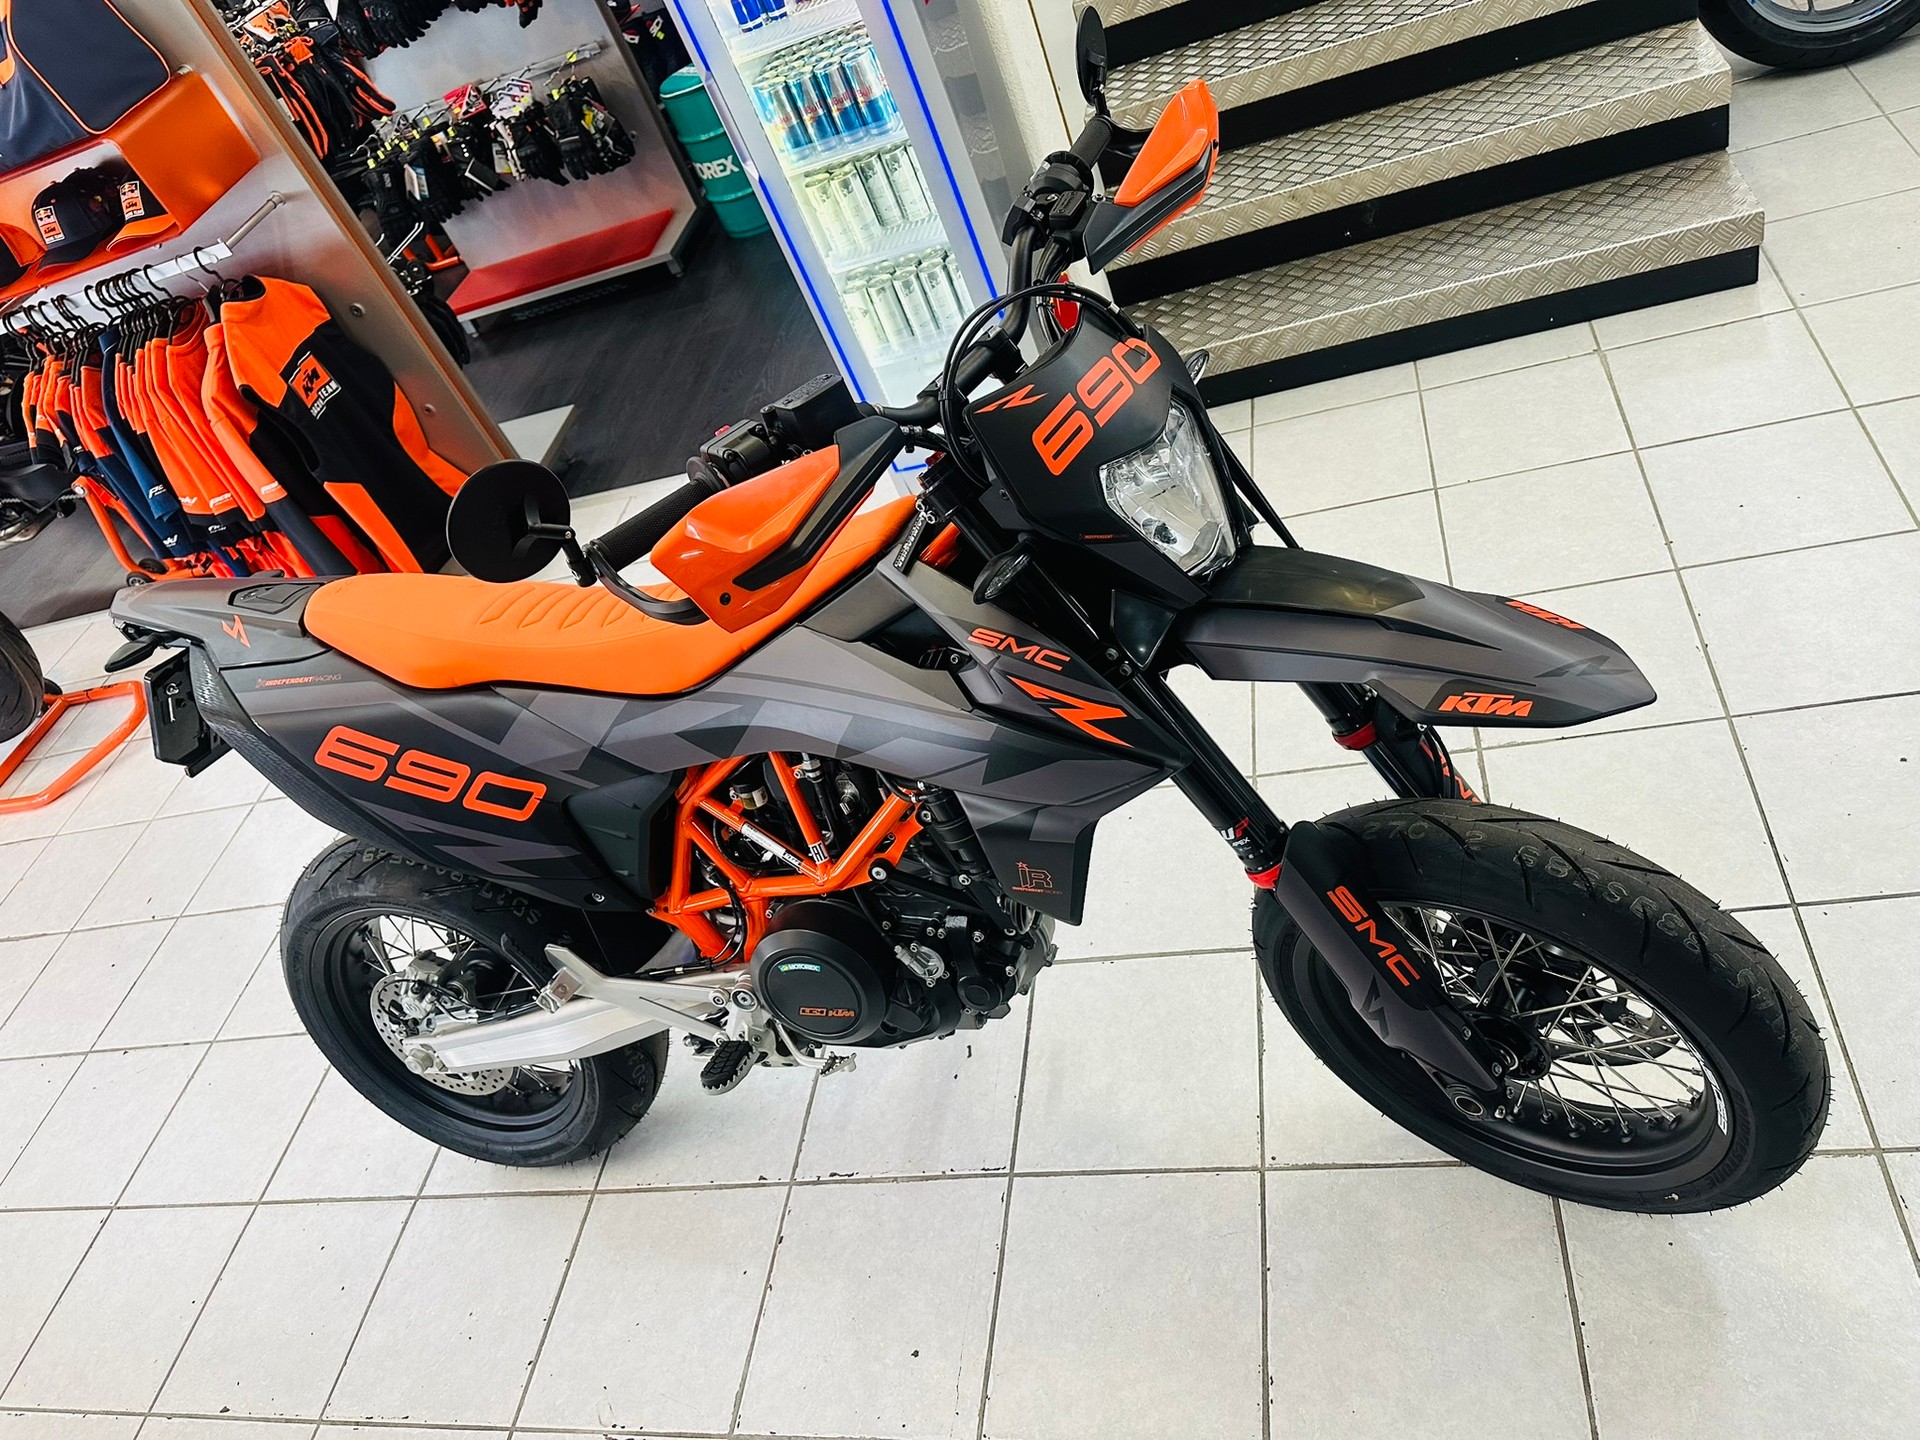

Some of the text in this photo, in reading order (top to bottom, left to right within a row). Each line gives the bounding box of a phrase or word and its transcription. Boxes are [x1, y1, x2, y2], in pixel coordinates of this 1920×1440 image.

[692, 155, 740, 180] OREX
[302, 366, 321, 399] KTM
[1031, 337, 1161, 476] 690
[967, 627, 1071, 671] SMC
[1438, 691, 1534, 717] KTM
[314, 725, 547, 822] 690
[1326, 885, 1421, 987] SMC
[828, 1008, 855, 1017] KTM
